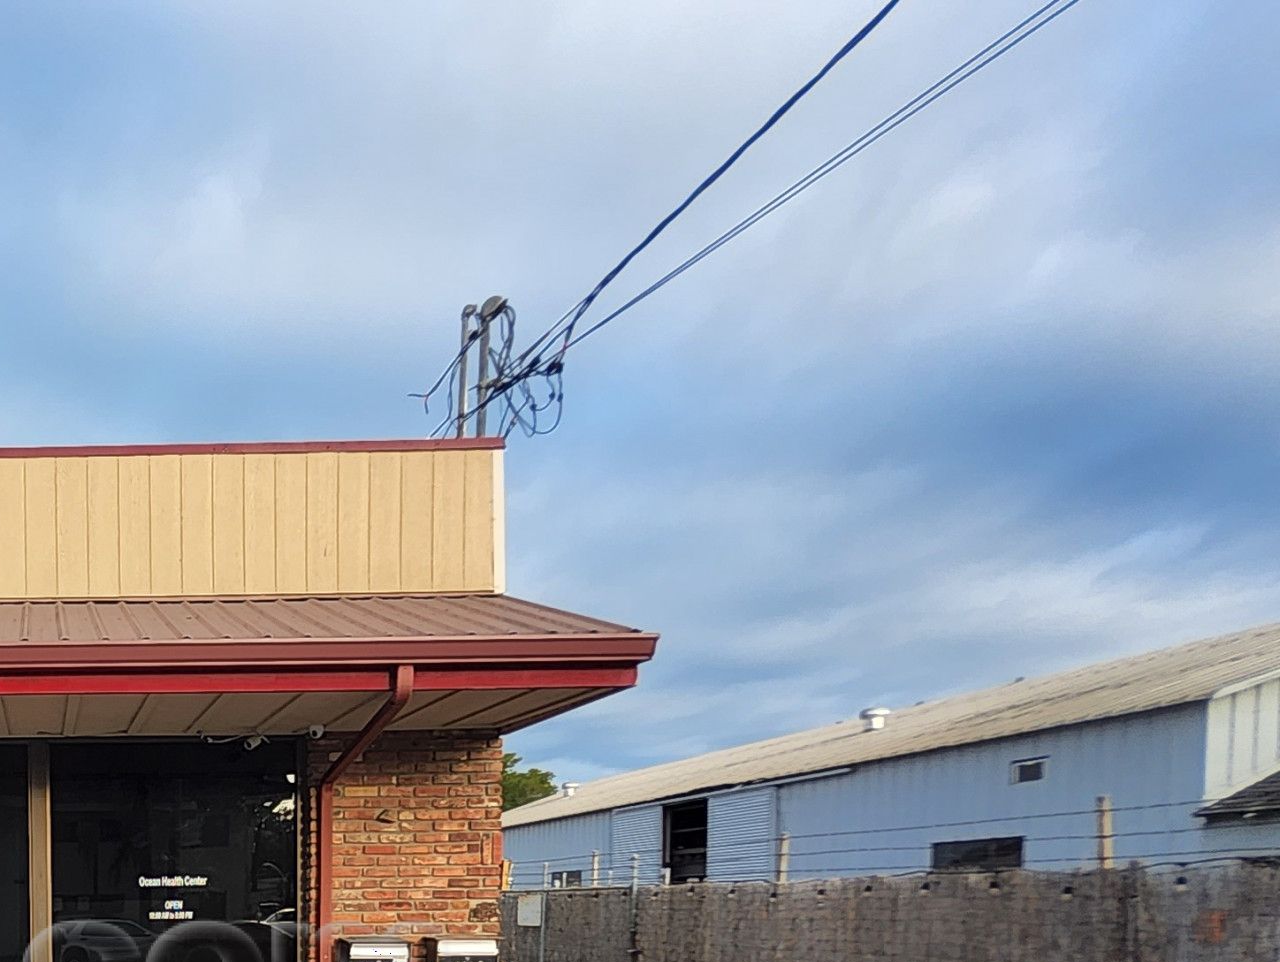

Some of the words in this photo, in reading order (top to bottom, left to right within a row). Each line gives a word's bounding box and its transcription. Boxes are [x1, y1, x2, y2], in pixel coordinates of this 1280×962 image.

[138, 876, 161, 888] Ocean
[161, 875, 184, 887] Health
[184, 875, 208, 887] Center
[164, 900, 184, 910] OPEN
